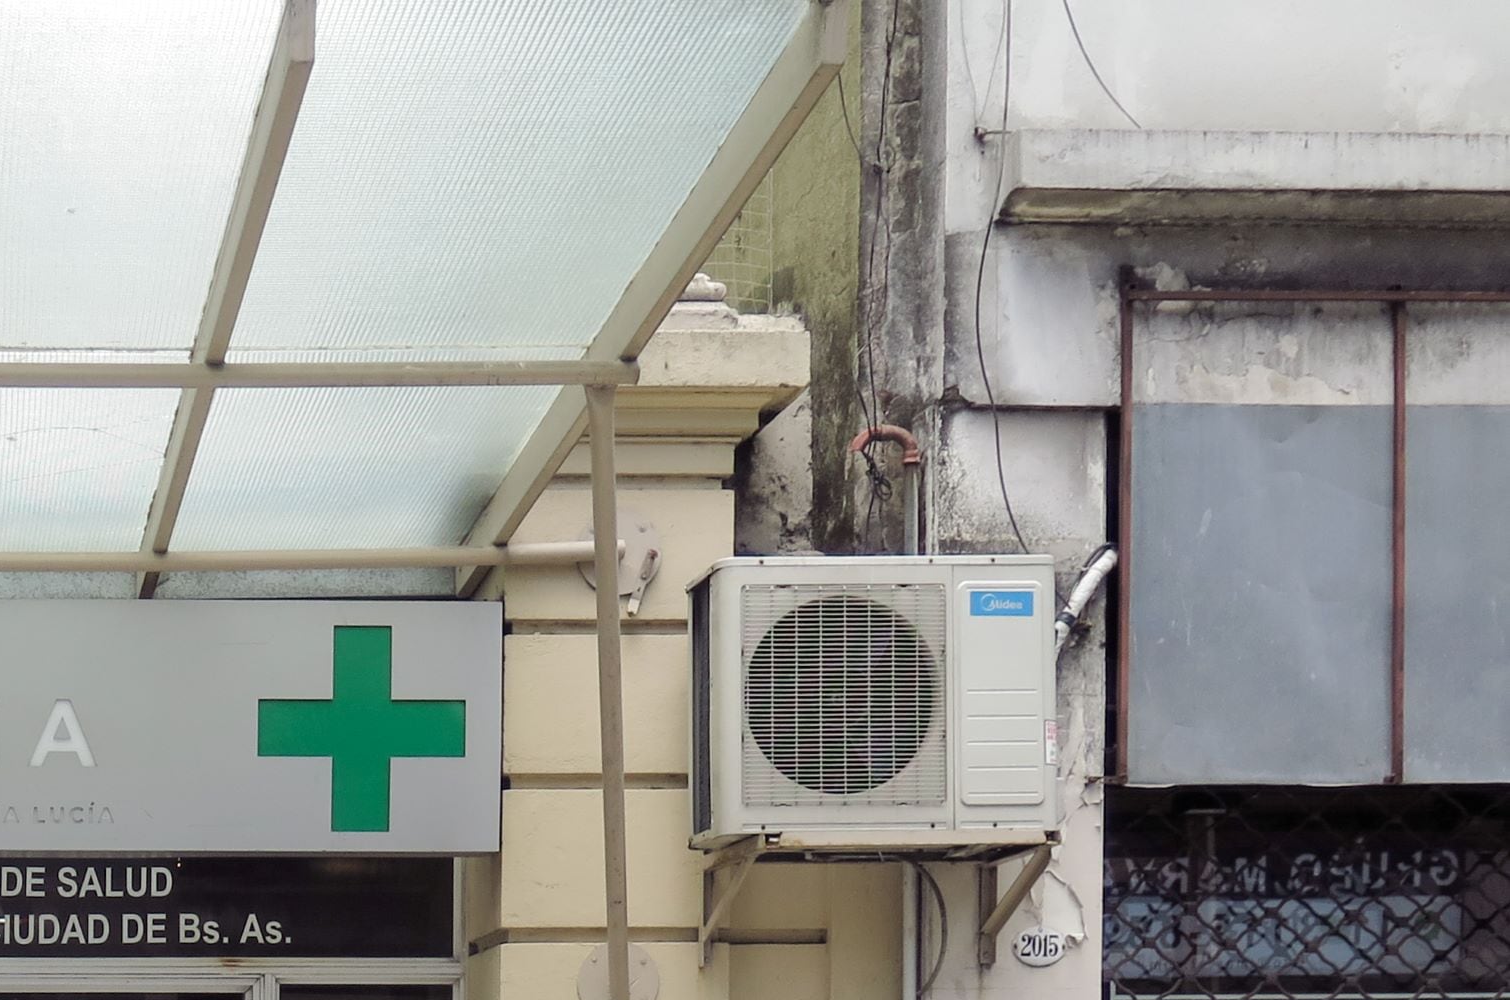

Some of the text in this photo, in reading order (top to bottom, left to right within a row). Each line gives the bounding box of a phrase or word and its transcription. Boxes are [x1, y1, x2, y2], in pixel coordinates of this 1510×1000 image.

[983, 596, 1023, 610] Midea
[33, 802, 115, 823] LUCÍA
[0, 866, 46, 897] DE
[57, 866, 173, 898] SALUD
[122, 914, 167, 944] DE
[178, 913, 229, 944] Bs.
[240, 913, 292, 944] As.
[1021, 934, 1059, 957] 2015
